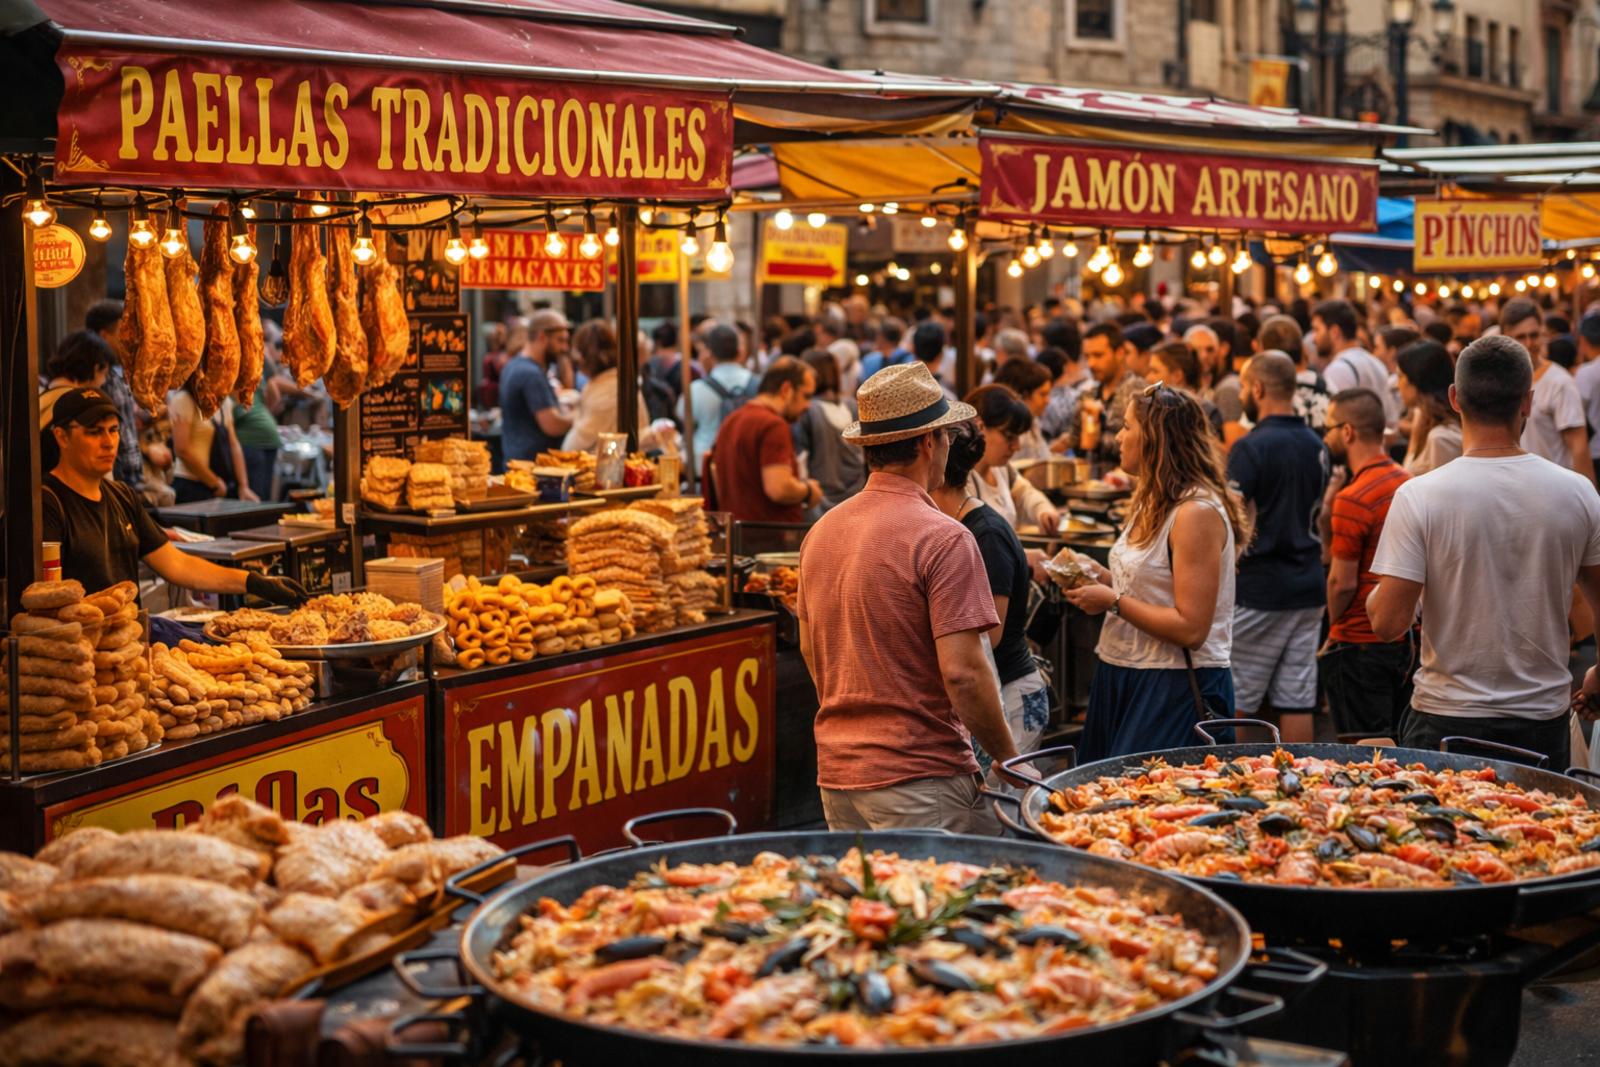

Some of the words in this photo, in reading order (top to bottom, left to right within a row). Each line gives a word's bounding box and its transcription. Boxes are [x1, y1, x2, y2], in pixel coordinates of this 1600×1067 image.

[119, 65, 349, 170] PAELLAS
[372, 86, 708, 182] TRADICIONALES
[1031, 153, 1176, 214] JAMÓN
[1191, 166, 1359, 223] ARTESANO
[467, 657, 759, 837] EMPANADAS
